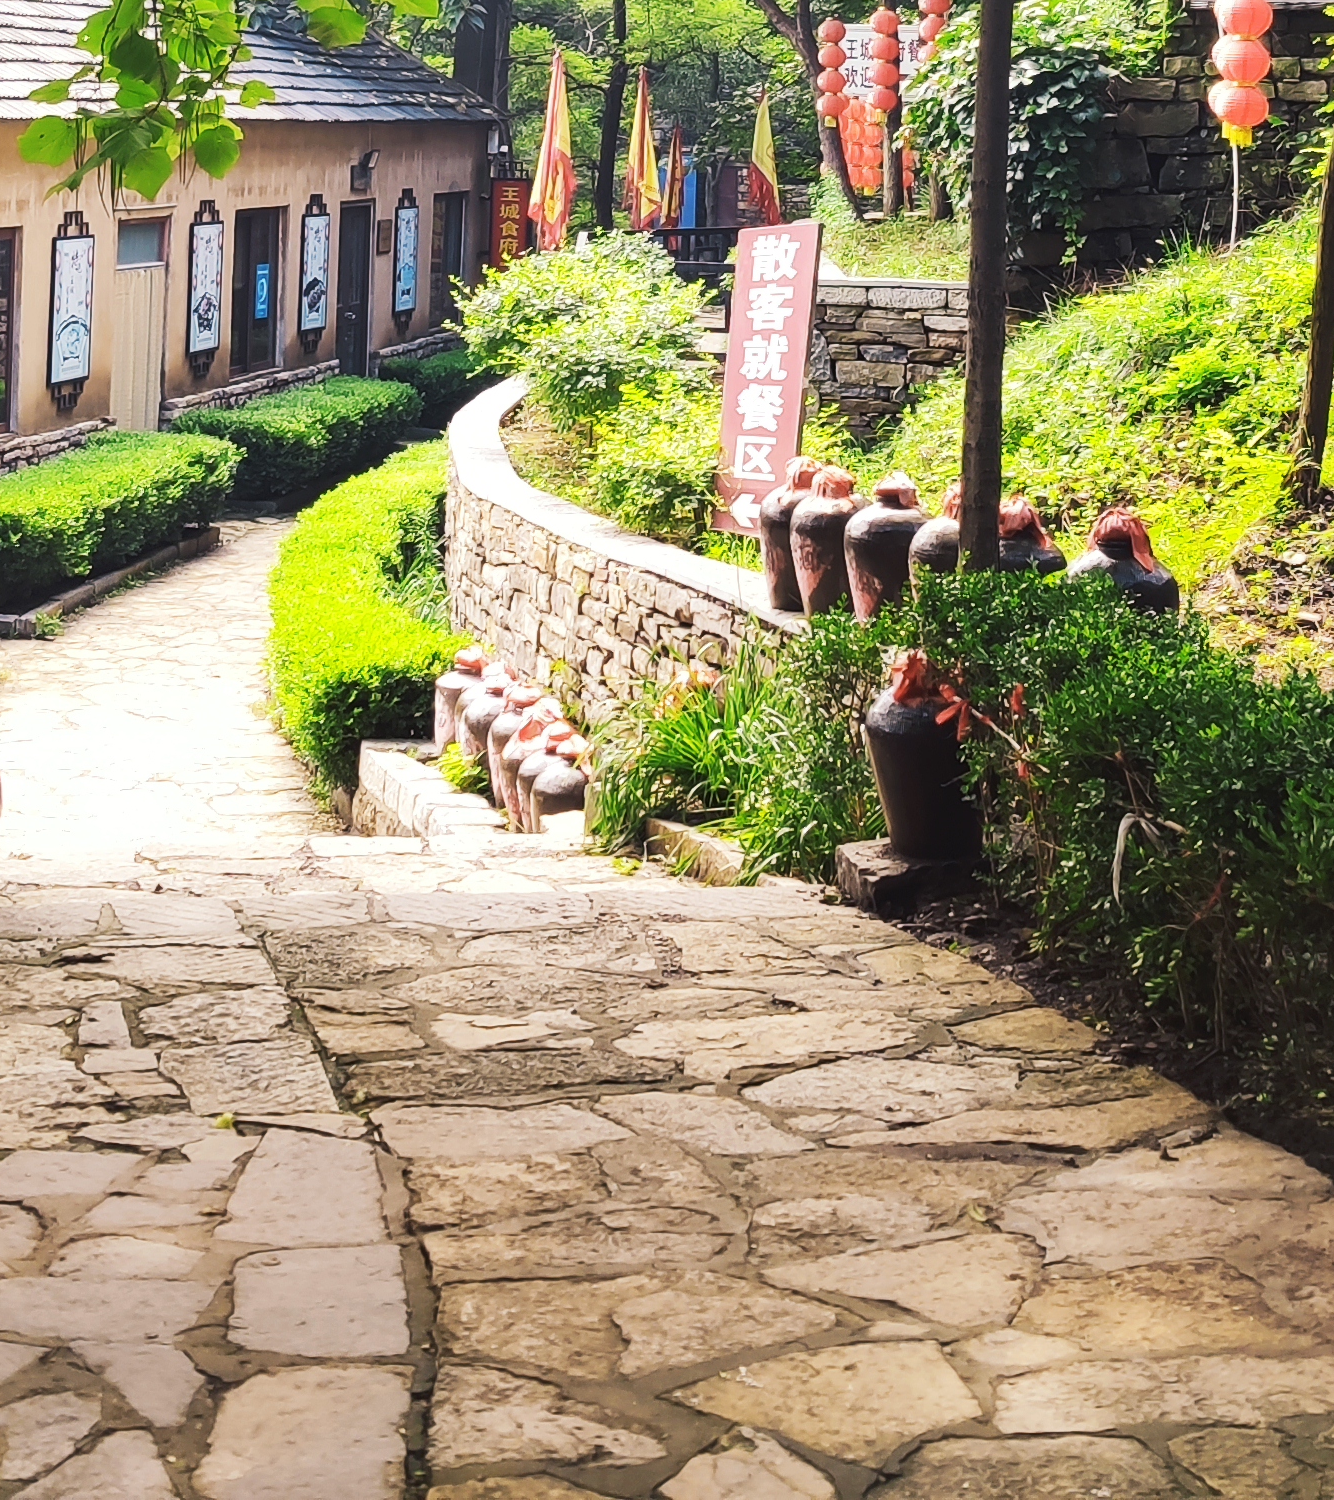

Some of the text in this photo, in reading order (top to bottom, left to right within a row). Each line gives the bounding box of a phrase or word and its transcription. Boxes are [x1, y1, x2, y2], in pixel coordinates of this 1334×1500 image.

[733, 232, 802, 482] 散客就餐区
